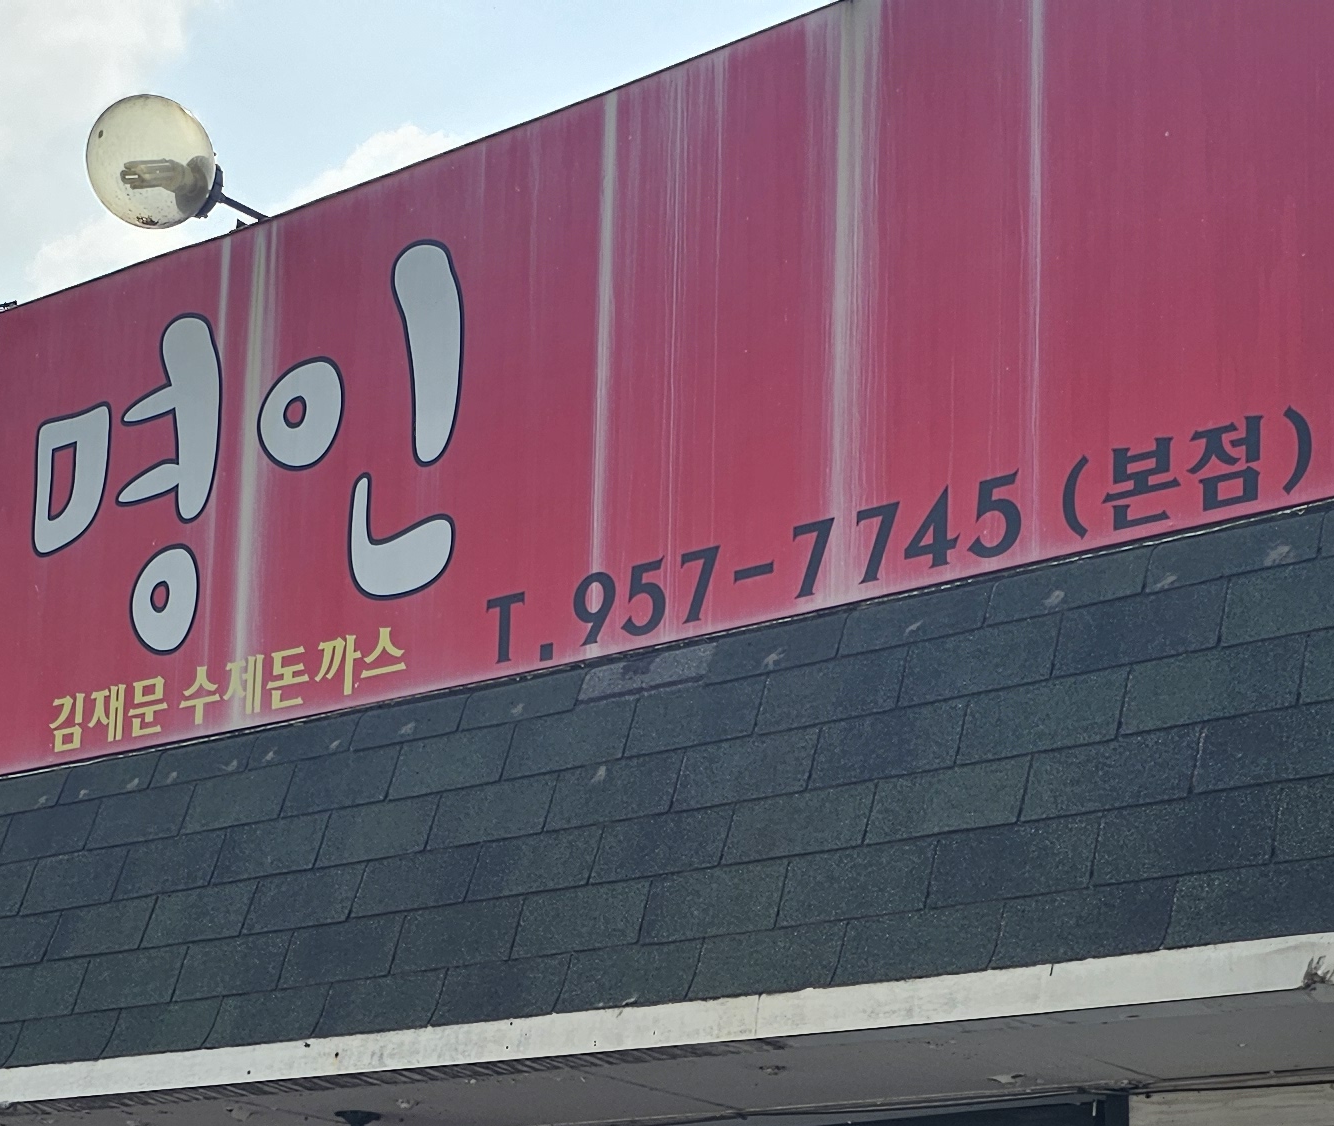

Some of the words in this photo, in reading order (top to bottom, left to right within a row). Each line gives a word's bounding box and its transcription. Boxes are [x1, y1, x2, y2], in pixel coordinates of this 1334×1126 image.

[32, 239, 464, 655] 명인
[1062, 406, 1313, 540] (본점)
[48, 674, 169, 752] 김재문
[178, 626, 407, 725] 수제돈까스
